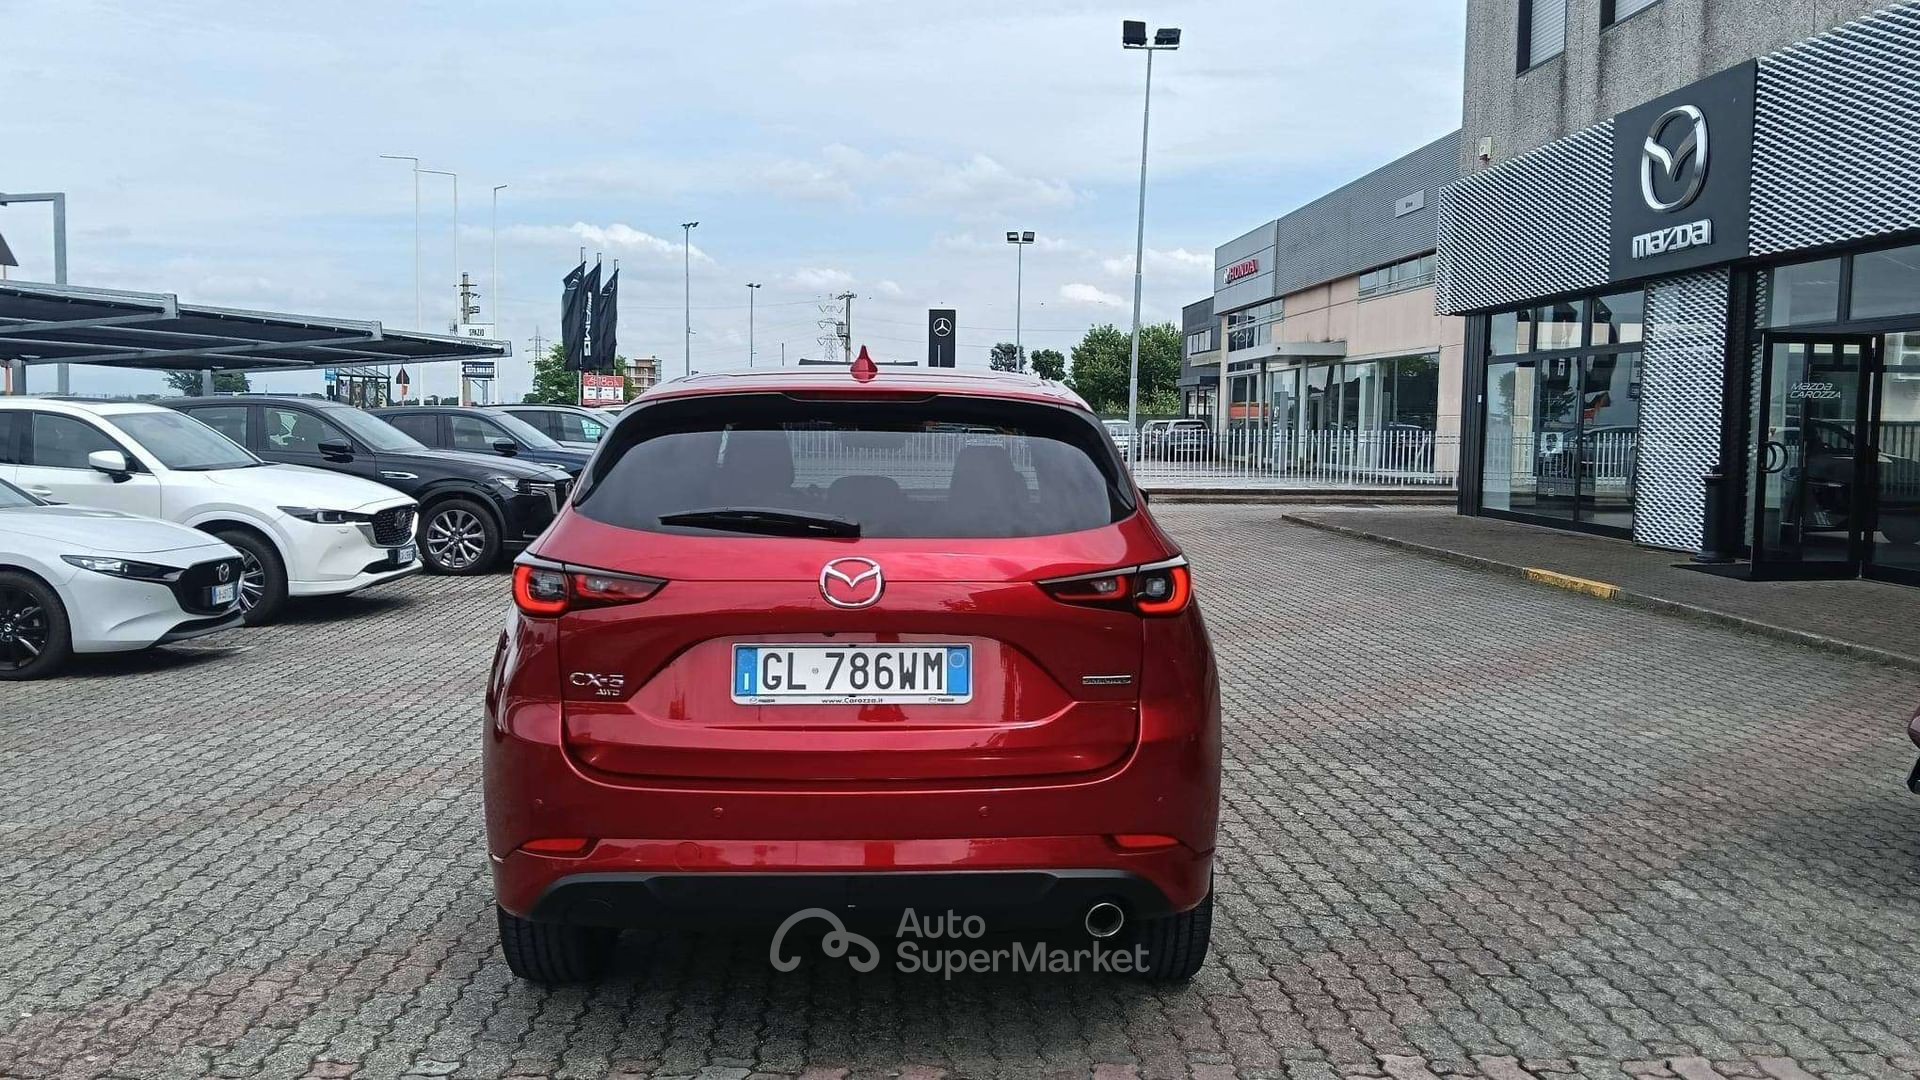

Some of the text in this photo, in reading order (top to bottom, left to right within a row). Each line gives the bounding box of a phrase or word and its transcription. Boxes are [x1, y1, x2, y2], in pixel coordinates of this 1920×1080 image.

[1229, 259, 1258, 280] HONDA
[1789, 391, 1841, 399] CAROZZA
[762, 652, 943, 691] GL 786WM
[570, 672, 624, 688] CX-5
[595, 688, 620, 696] AWD
